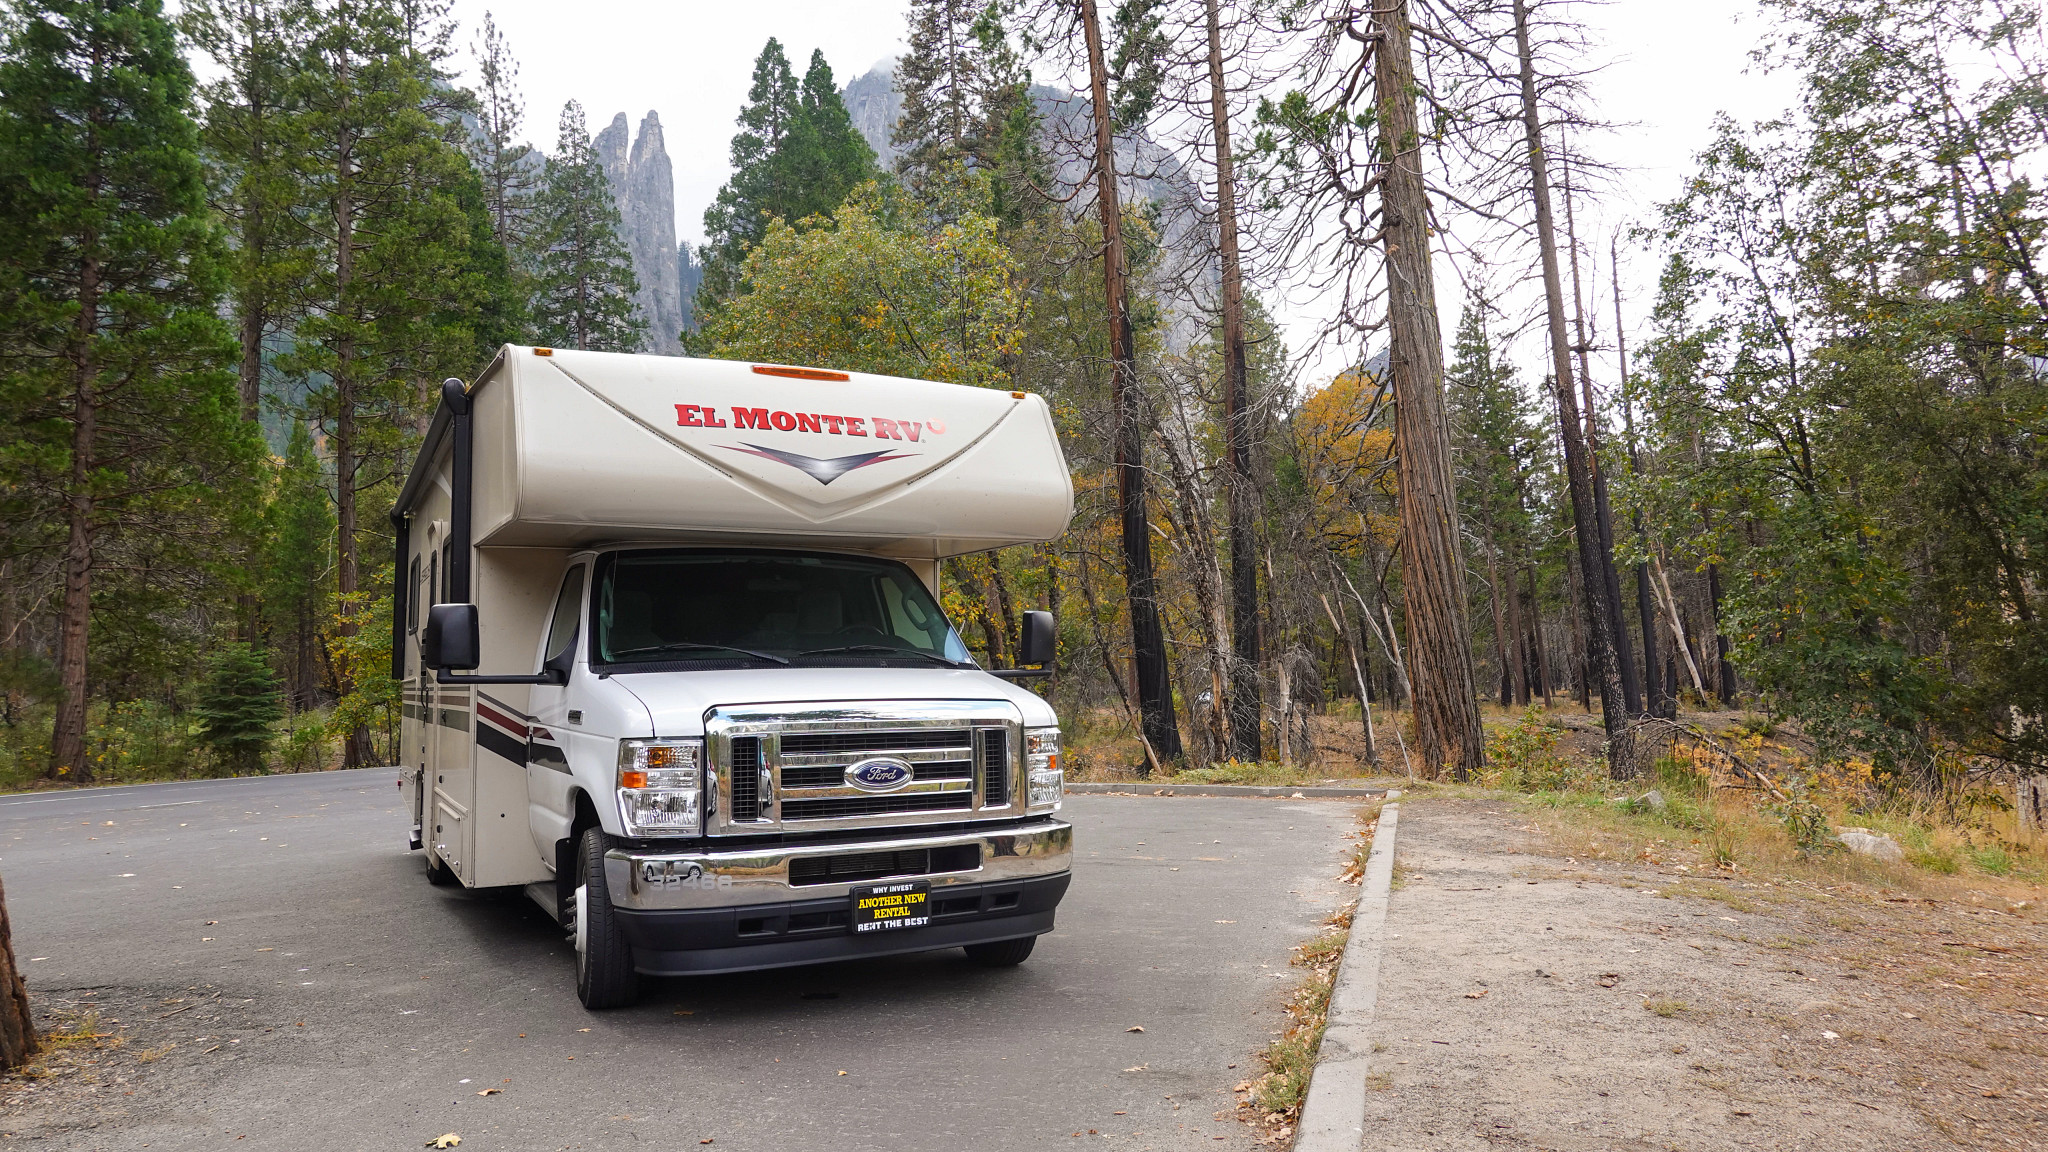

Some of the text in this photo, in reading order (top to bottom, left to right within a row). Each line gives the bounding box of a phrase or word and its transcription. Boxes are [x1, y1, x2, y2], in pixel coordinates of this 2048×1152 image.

[674, 404, 922, 442] EL MONTE RV
[867, 766, 897, 781] Ford
[872, 884, 914, 894] WHY INVEST
[858, 892, 926, 909] ANOTHER NEW
[873, 906, 911, 919] RENTAL
[857, 916, 929, 932] RENT THE BEST
